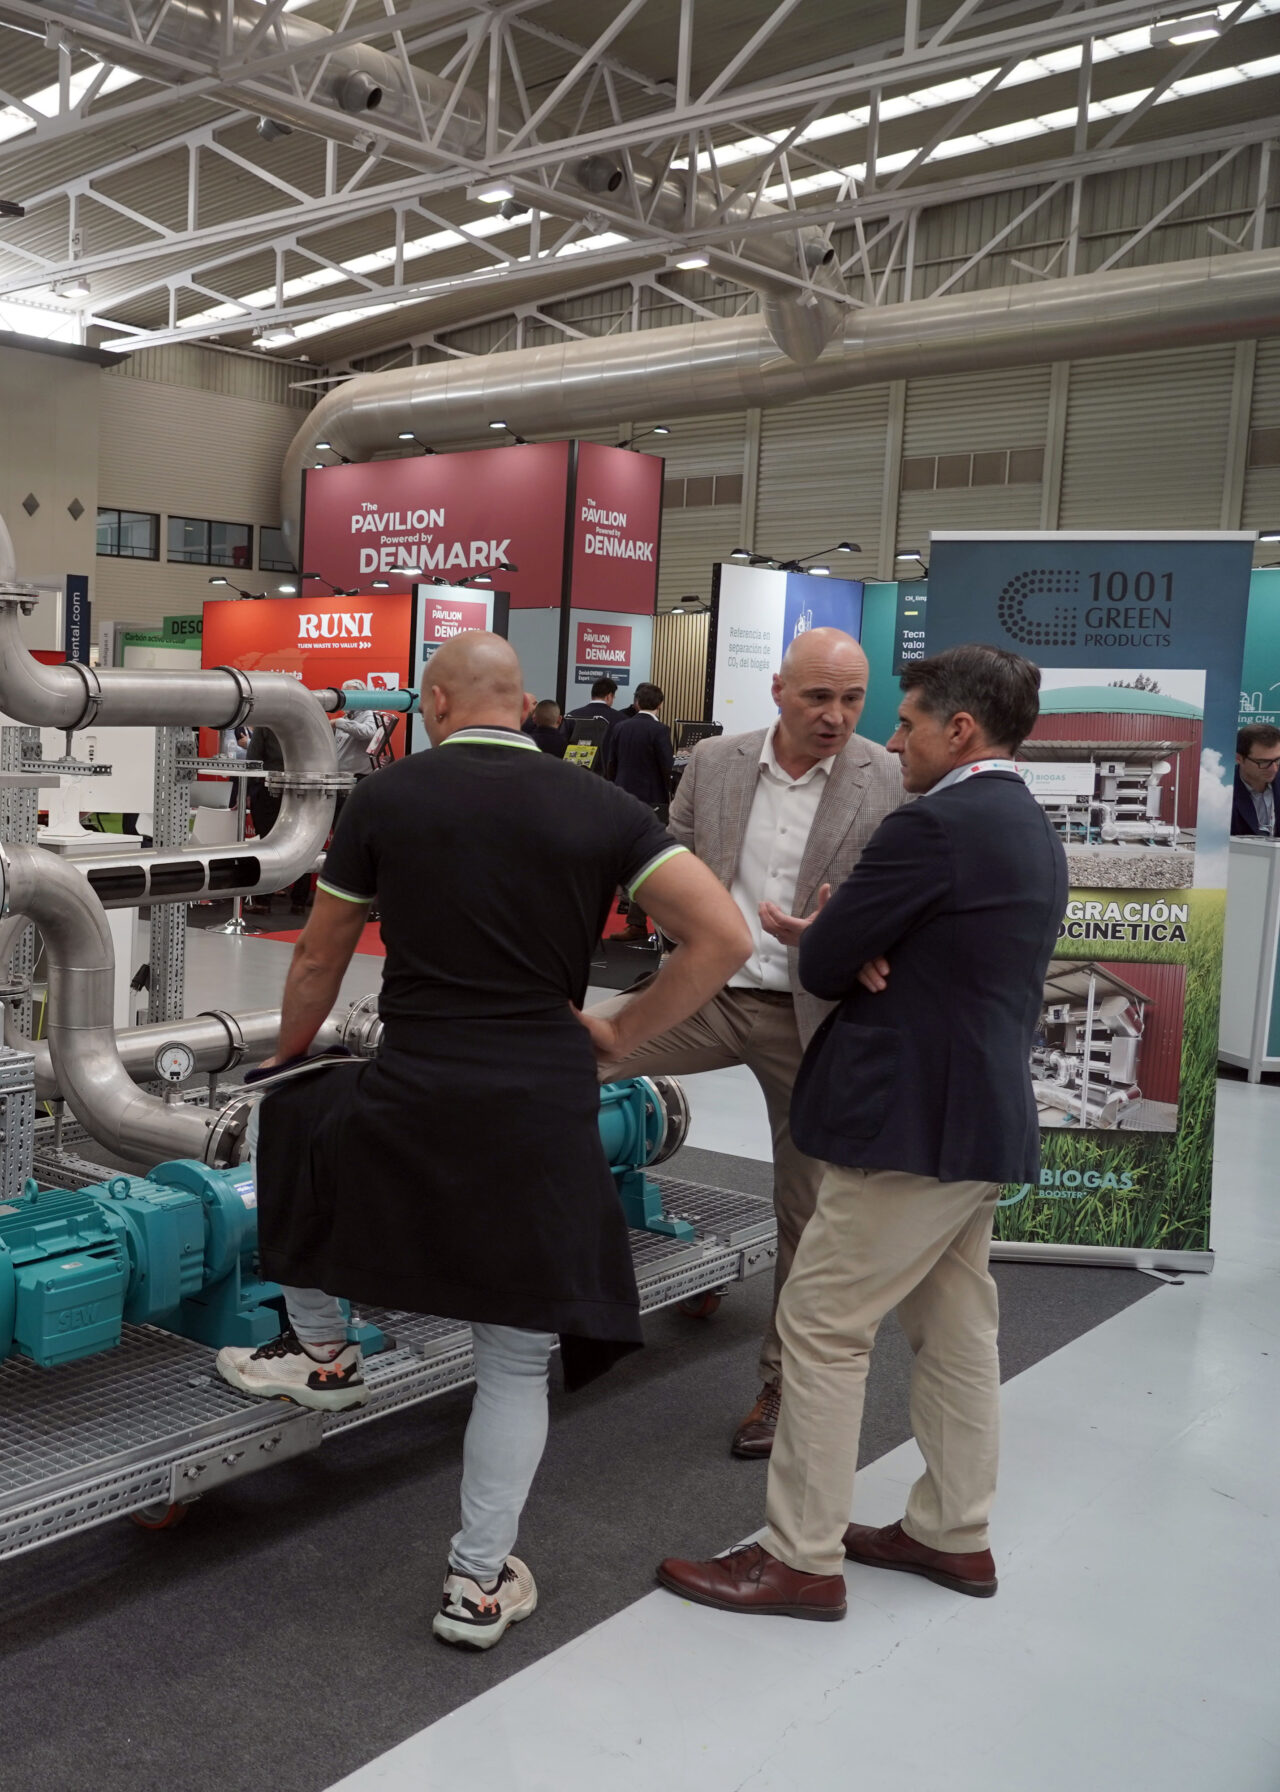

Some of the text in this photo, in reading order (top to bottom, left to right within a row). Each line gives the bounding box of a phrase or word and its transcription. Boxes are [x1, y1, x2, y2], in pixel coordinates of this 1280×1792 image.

[361, 502, 378, 511] The
[587, 498, 596, 506] The
[351, 508, 445, 533] PAVILION
[581, 506, 627, 528] PAVILION
[380, 533, 433, 544] Powered by
[359, 539, 511, 573] DENMARK
[585, 533, 654, 562] DENMARK
[1089, 571, 1173, 602] 1001
[432, 609, 462, 620] PAVILION
[1085, 607, 1171, 629] GREEN
[297, 613, 373, 638] RUNI
[729, 626, 761, 640] Referencia
[903, 630, 925, 638] Tecn
[583, 633, 610, 643] PAVILION
[1085, 634, 1171, 647] PRODUCTS
[585, 648, 626, 662] DENMARK
[1066, 899, 1188, 923] GRACIÓN
[1040, 1168, 1133, 1189] BIOGAS
